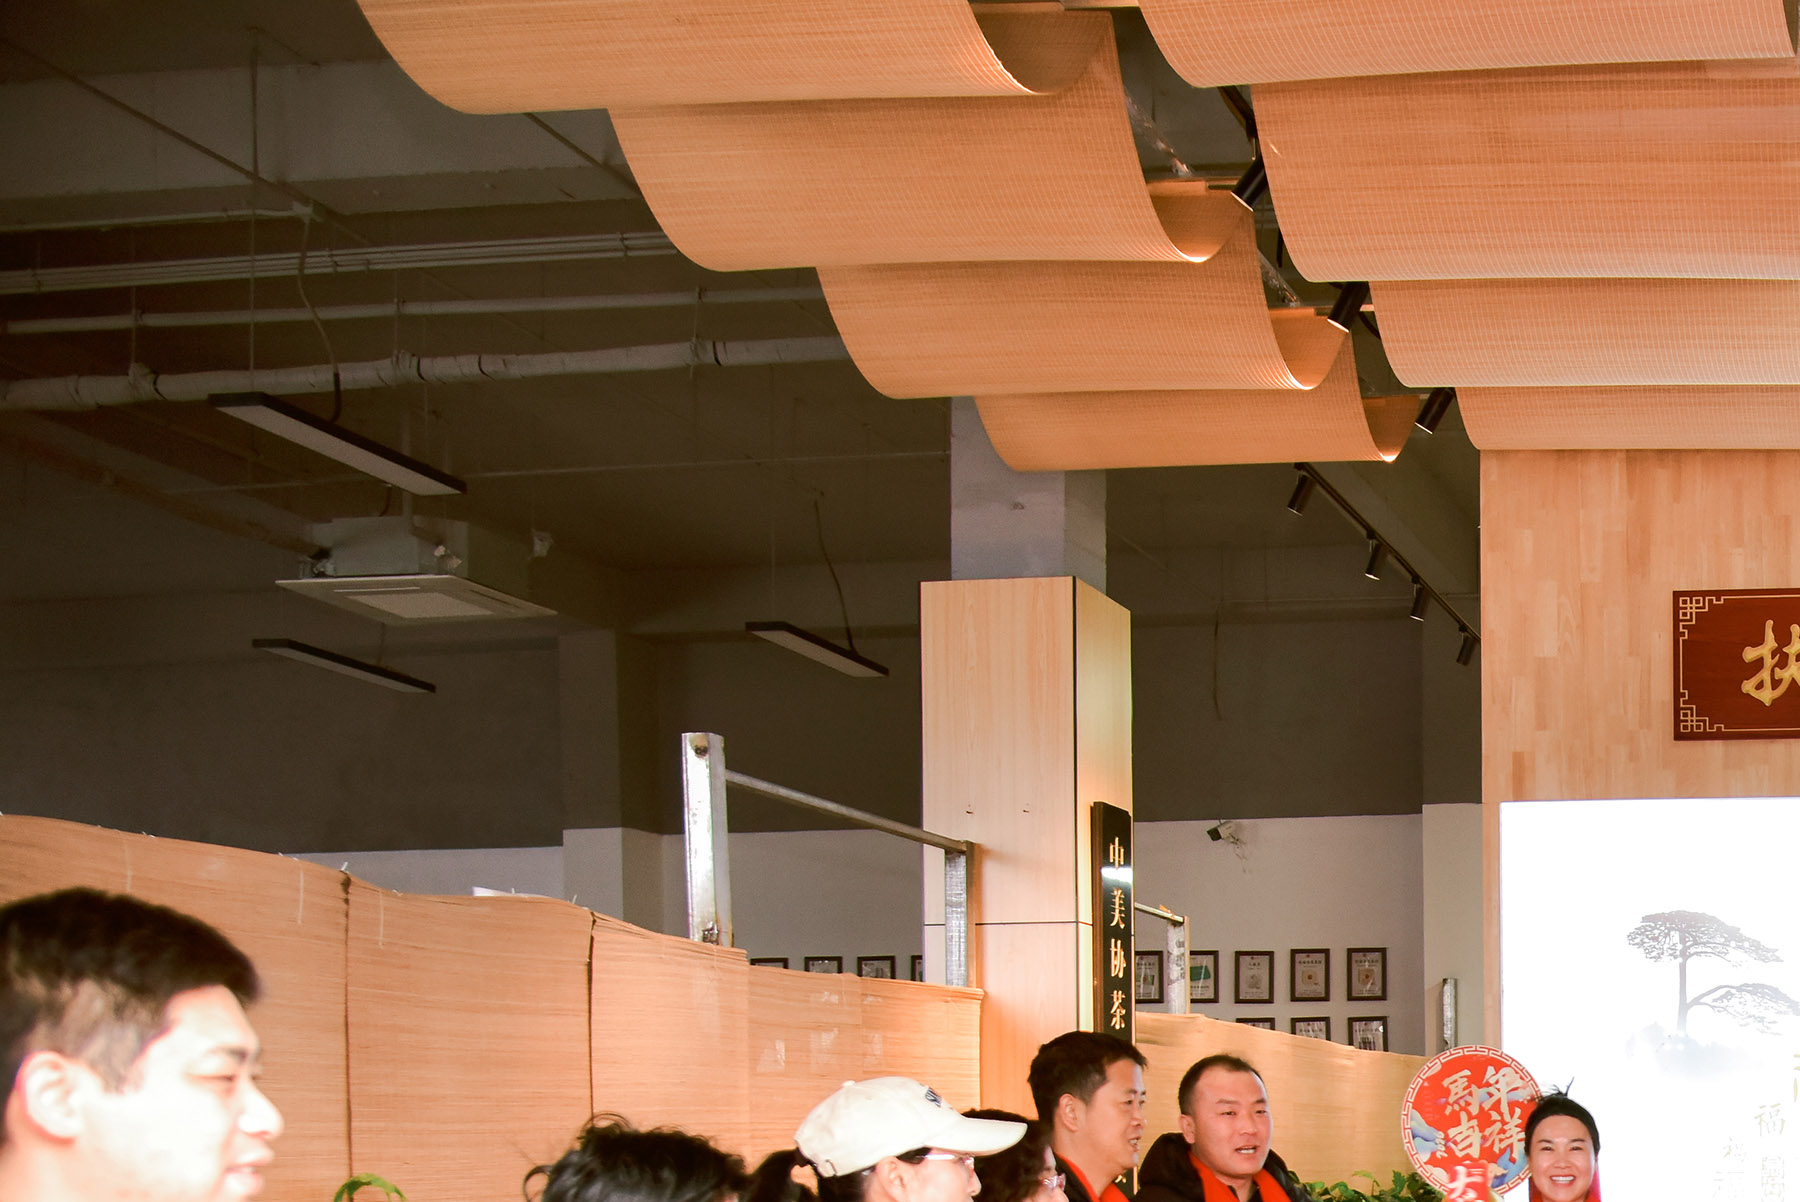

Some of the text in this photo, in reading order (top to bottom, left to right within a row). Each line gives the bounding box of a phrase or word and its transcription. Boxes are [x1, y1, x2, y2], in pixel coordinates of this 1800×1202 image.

[1109, 836, 1127, 1030] 中美协茶
[1447, 1107, 1526, 1160] 吉祥
